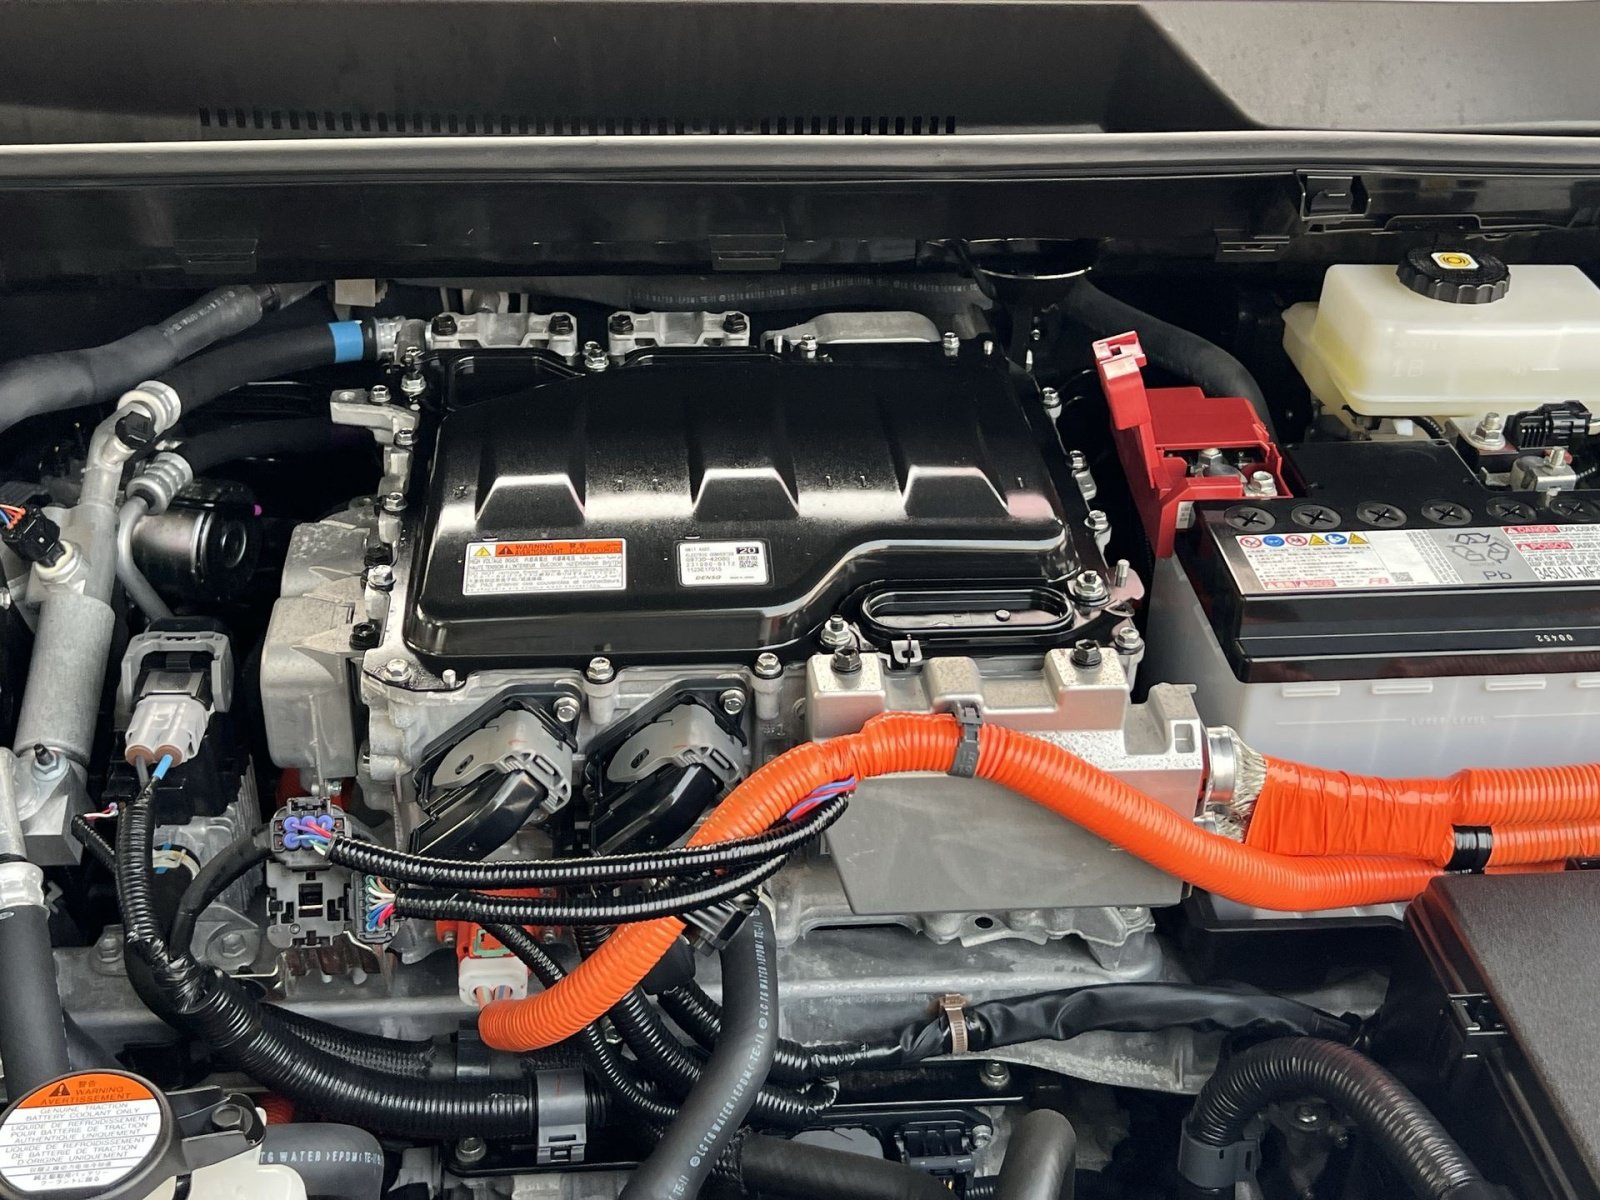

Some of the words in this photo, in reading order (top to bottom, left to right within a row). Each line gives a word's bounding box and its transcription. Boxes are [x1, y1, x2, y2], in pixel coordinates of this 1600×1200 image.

[1483, 571, 1512, 580] Pb
[758, 966, 769, 990] WATER
[76, 1086, 124, 1095] WARNING
[42, 1093, 131, 1105] AVERTISSEMENT
[40, 1106, 79, 1114] GENUINE
[70, 1110, 111, 1118] COOLANT
[68, 1115, 150, 1127] REFROIDISSEMENT
[712, 1102, 735, 1132] WATER
[15, 1134, 76, 1144] AUTHENTIQUE
[82, 1128, 141, 1138] UNIQUEMENT
[41, 1127, 82, 1136] BATTERIE
[63, 1137, 146, 1148] REFROIDISSEMENT
[69, 1152, 128, 1161] UNIQUEMENT
[280, 1151, 321, 1162] WATER
